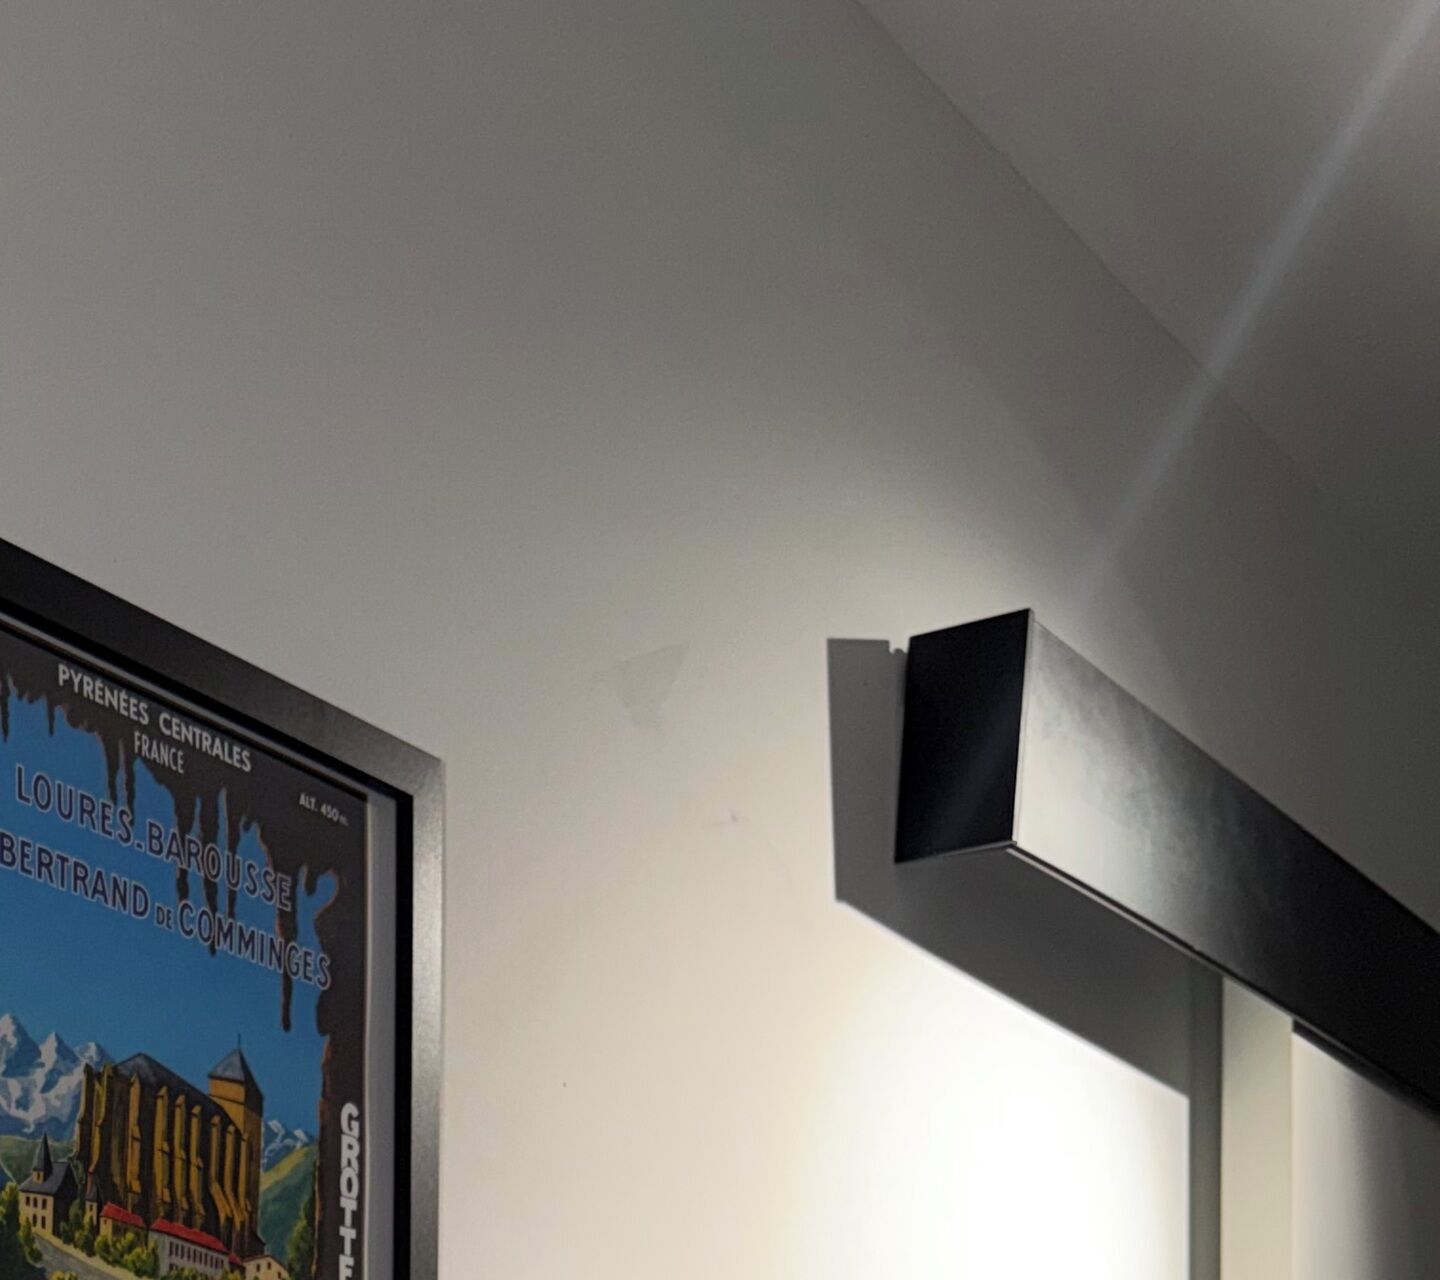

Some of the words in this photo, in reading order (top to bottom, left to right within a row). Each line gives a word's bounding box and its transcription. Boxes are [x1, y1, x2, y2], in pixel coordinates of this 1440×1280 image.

[58, 663, 150, 726] PYRÉNÉES
[159, 712, 252, 772] CENTRALES
[134, 730, 185, 774] FRANCE
[153, 903, 175, 931] DE
[178, 900, 332, 990] COMMINGES
